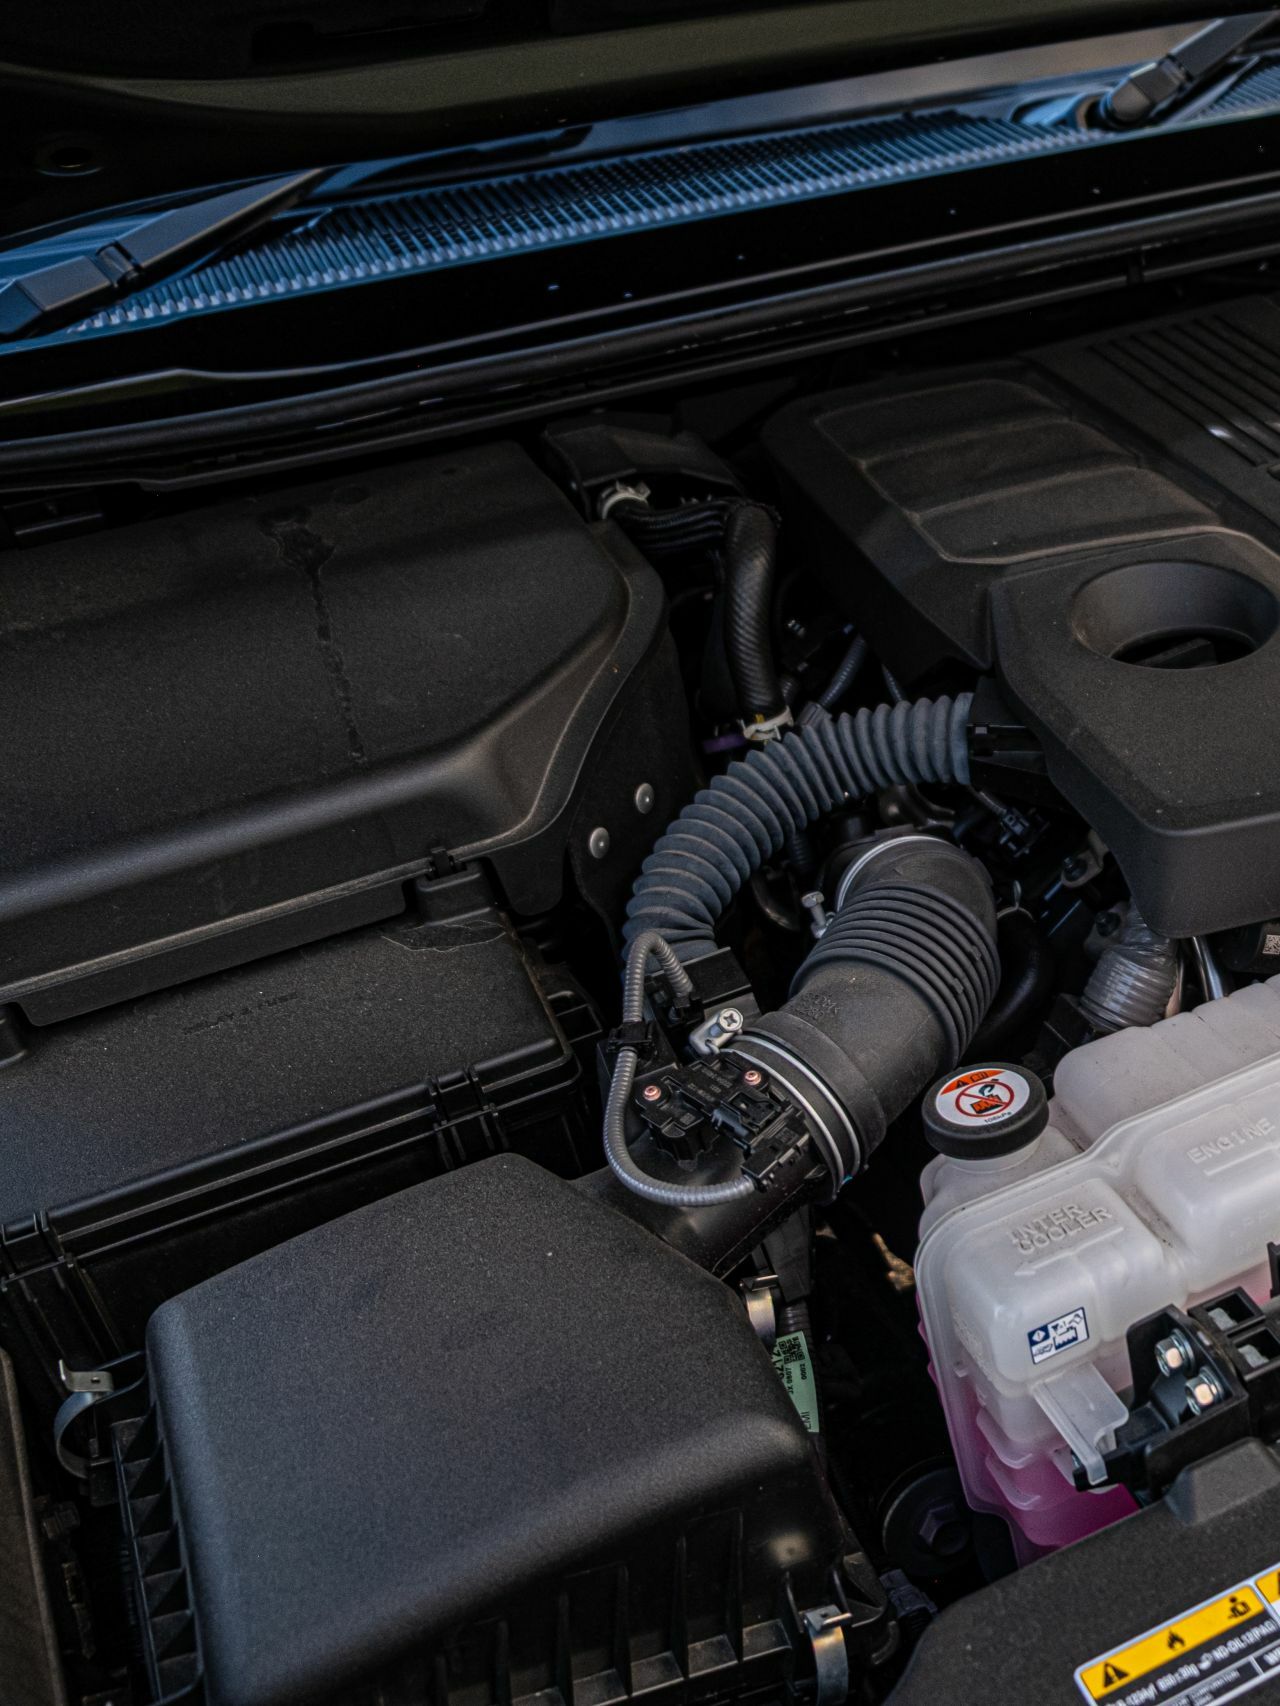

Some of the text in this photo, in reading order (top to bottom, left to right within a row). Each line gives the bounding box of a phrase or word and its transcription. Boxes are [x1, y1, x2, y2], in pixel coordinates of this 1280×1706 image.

[1186, 1117, 1276, 1165] ENGINE
[1008, 1204, 1083, 1245] INTER
[1018, 1207, 1112, 1255] COOLER
